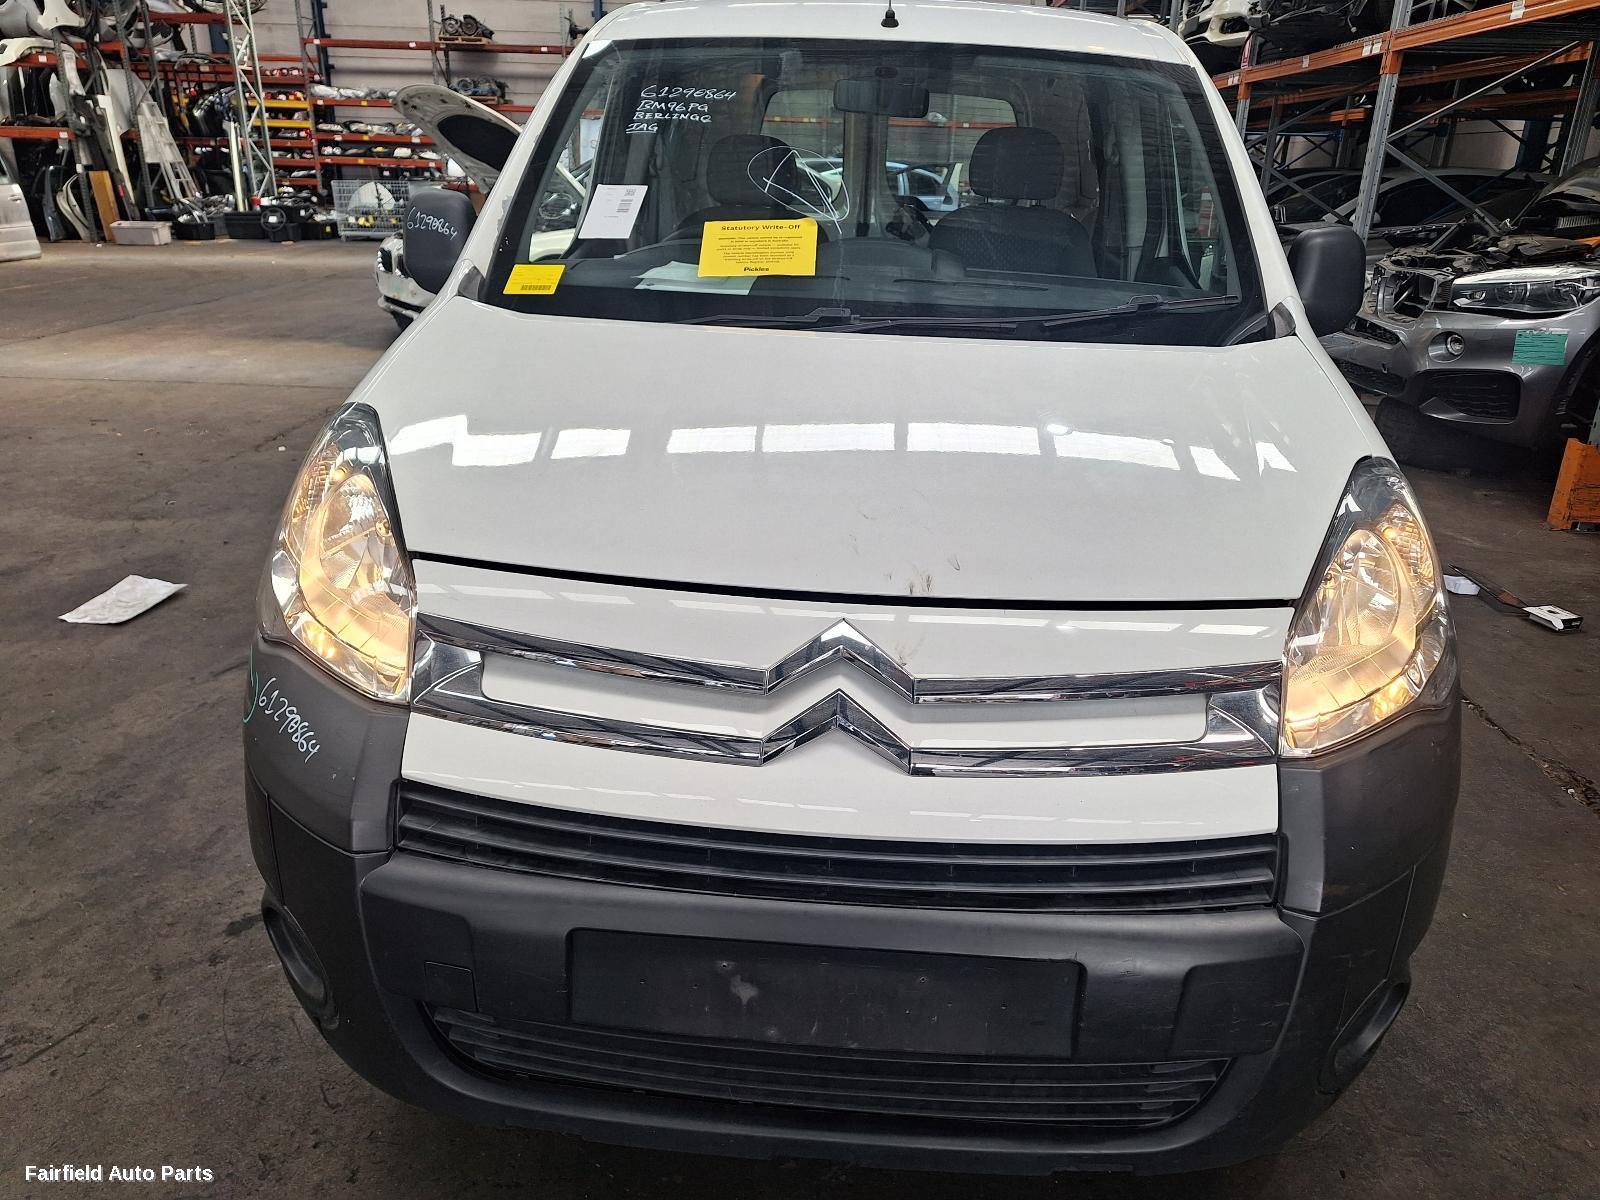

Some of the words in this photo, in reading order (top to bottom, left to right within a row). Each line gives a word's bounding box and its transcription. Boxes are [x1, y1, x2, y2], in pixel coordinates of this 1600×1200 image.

[640, 84, 737, 100] 61290864
[636, 100, 709, 112] BM96PG
[407, 206, 458, 241] 61290864
[258, 677, 321, 764] 61290864
